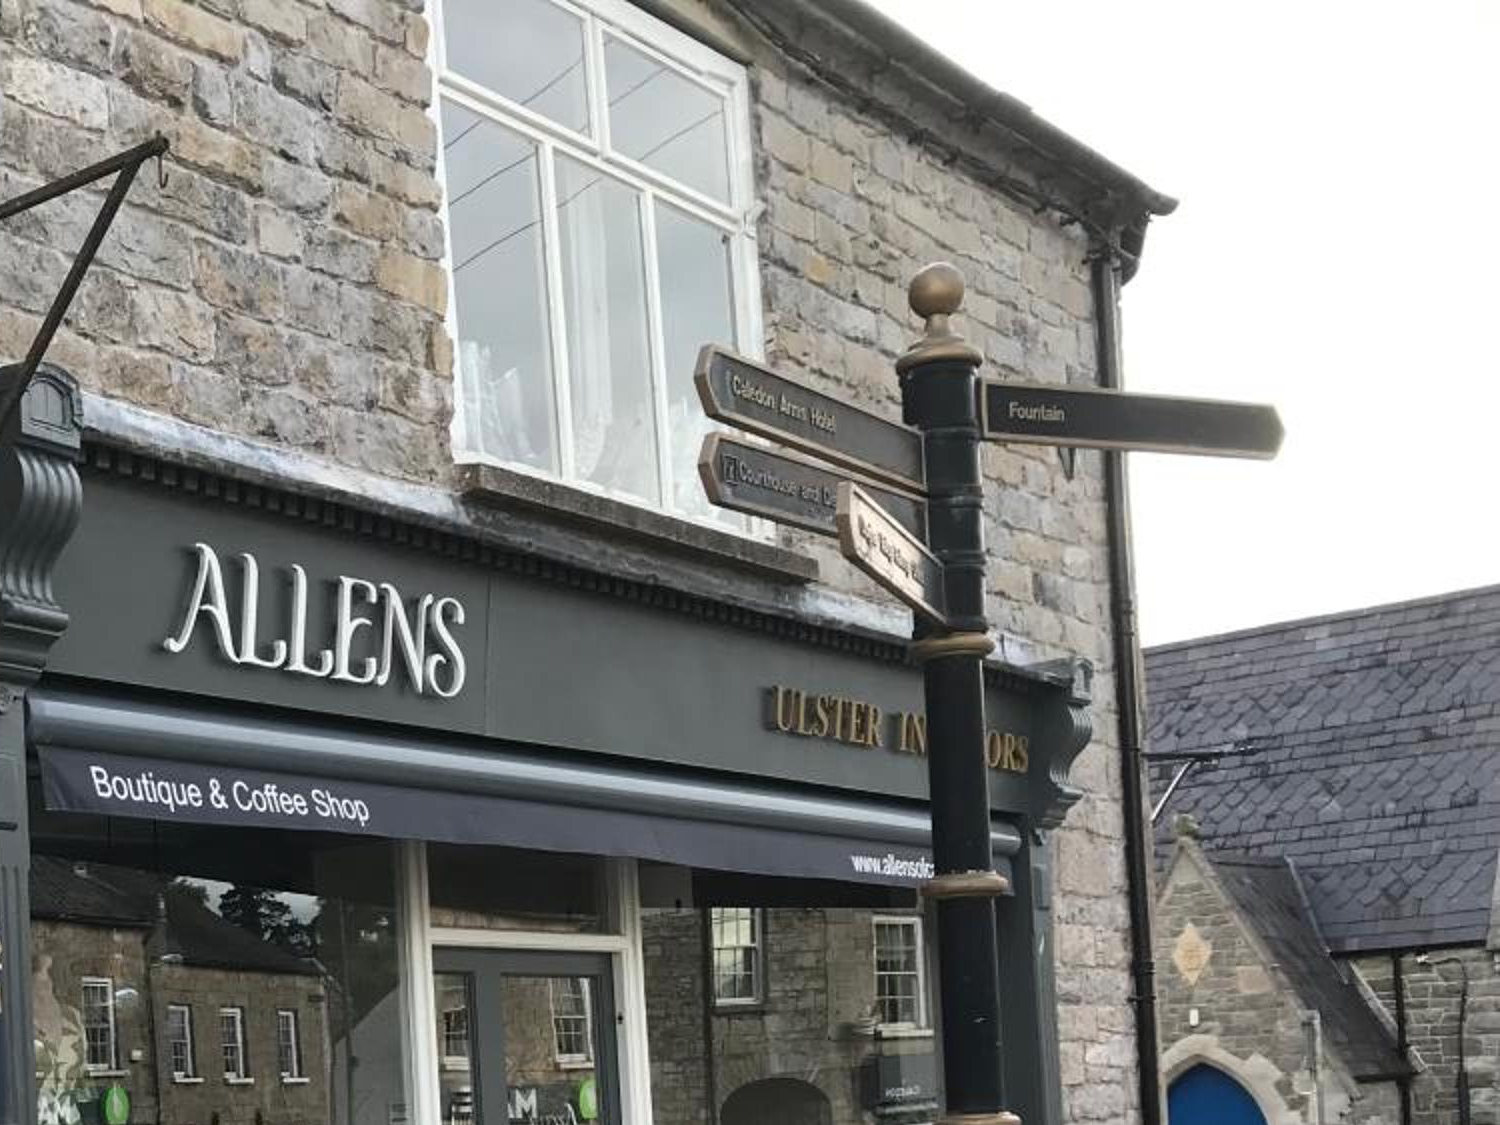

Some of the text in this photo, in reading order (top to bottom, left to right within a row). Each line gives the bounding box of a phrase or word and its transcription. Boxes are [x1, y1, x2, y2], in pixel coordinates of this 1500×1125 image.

[1008, 401, 1065, 422] Fountain
[739, 460, 797, 497] Courthouse
[163, 542, 466, 698] ALLENS
[772, 684, 1029, 774] ULSTER INORS
[89, 765, 370, 827] Boutique & Coffee Shop
